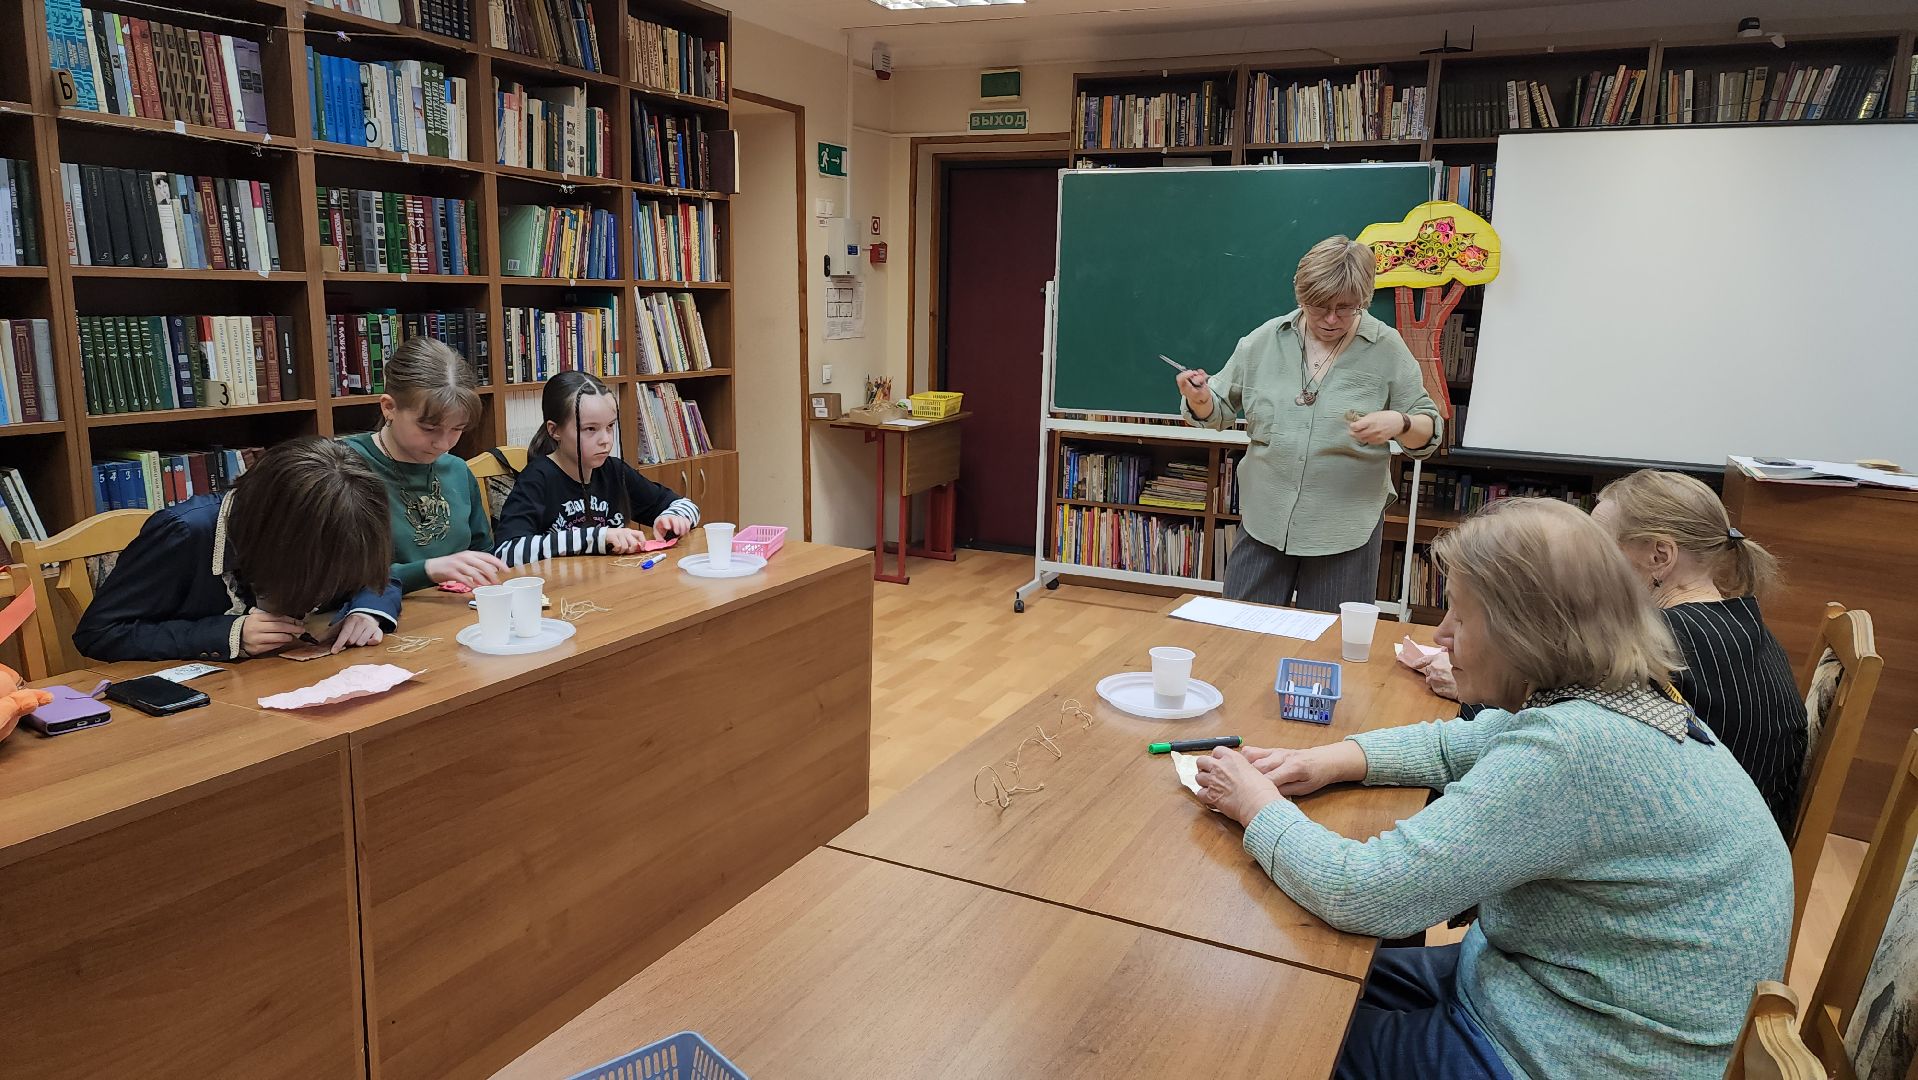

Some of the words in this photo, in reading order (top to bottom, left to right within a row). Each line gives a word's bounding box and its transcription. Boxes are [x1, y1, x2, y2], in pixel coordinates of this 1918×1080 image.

[423, 67, 429, 76] 4
[58, 71, 72, 100] Б
[424, 80, 434, 128] ПАНТЕЛЕЕВ
[236, 109, 244, 123] 2
[971, 113, 1025, 128] ВЫХОД
[64, 201, 75, 243] Булгаков
[99, 473, 105, 483] 5
[109, 471, 117, 482] 4
[125, 470, 131, 480] 3
[137, 469, 141, 479] 1
